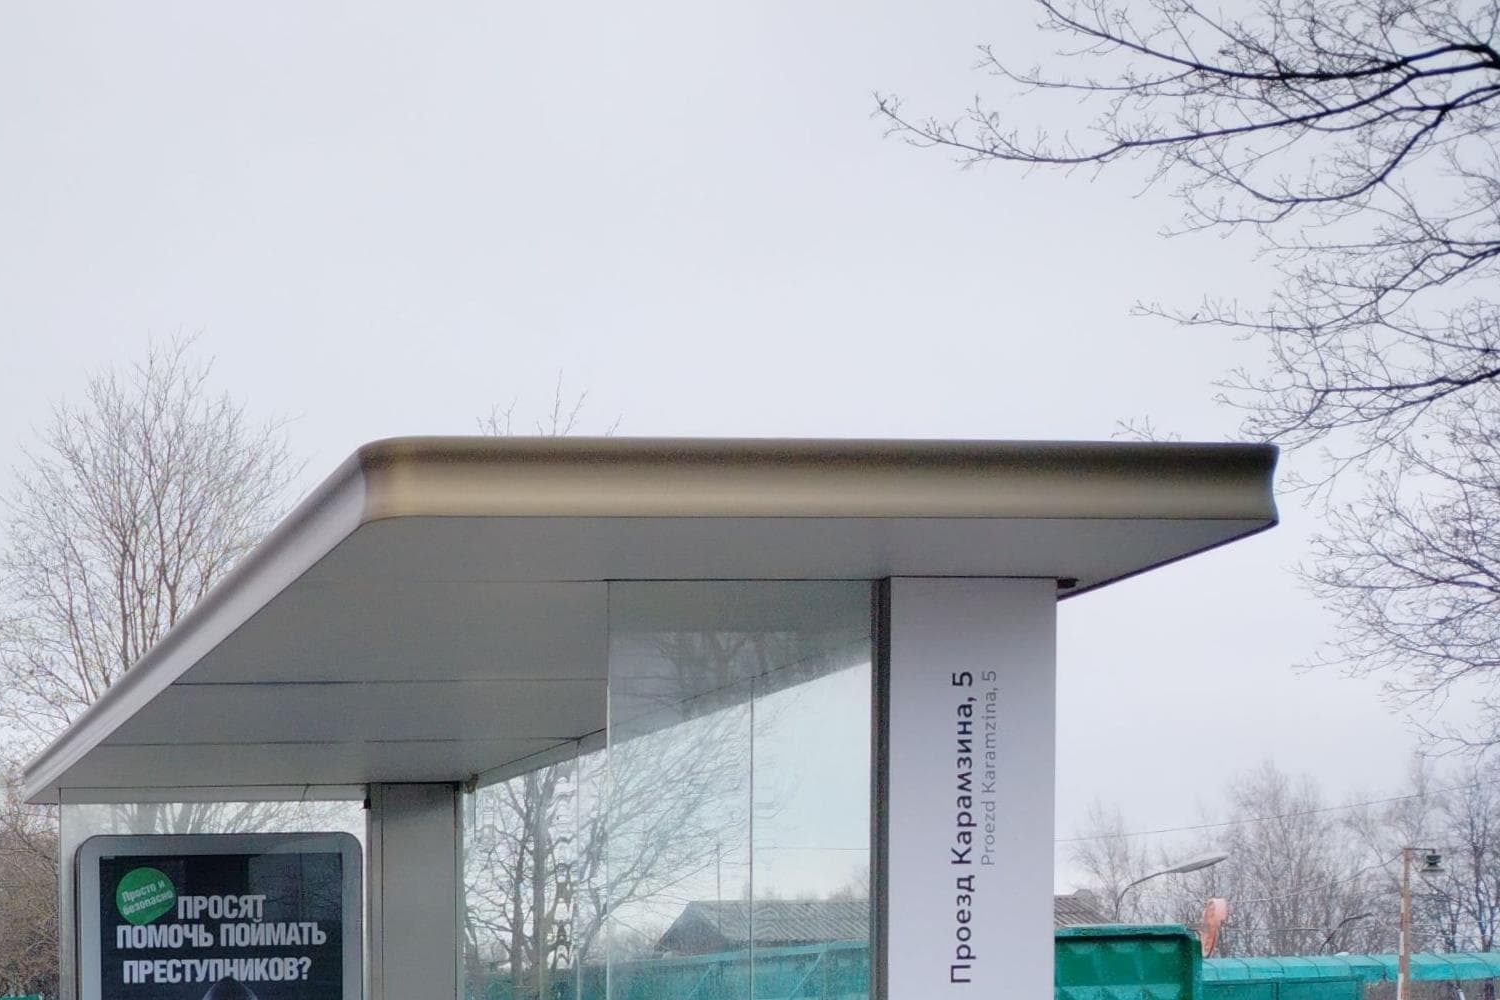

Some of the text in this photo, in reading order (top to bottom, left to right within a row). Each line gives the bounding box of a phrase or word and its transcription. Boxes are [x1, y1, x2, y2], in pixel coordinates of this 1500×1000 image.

[981, 670, 999, 867] Proezd Karamzina, 5
[951, 671, 977, 984] Проезд Карамзина, 5
[122, 880, 166, 903] Просто и
[122, 890, 174, 915] безопасно
[177, 894, 267, 920] ПРОСЯТ
[116, 918, 327, 949] ПОМОЧЬ ПОЙМАТЬ
[123, 957, 312, 984] ПРЕСТУПНИКОВ?
